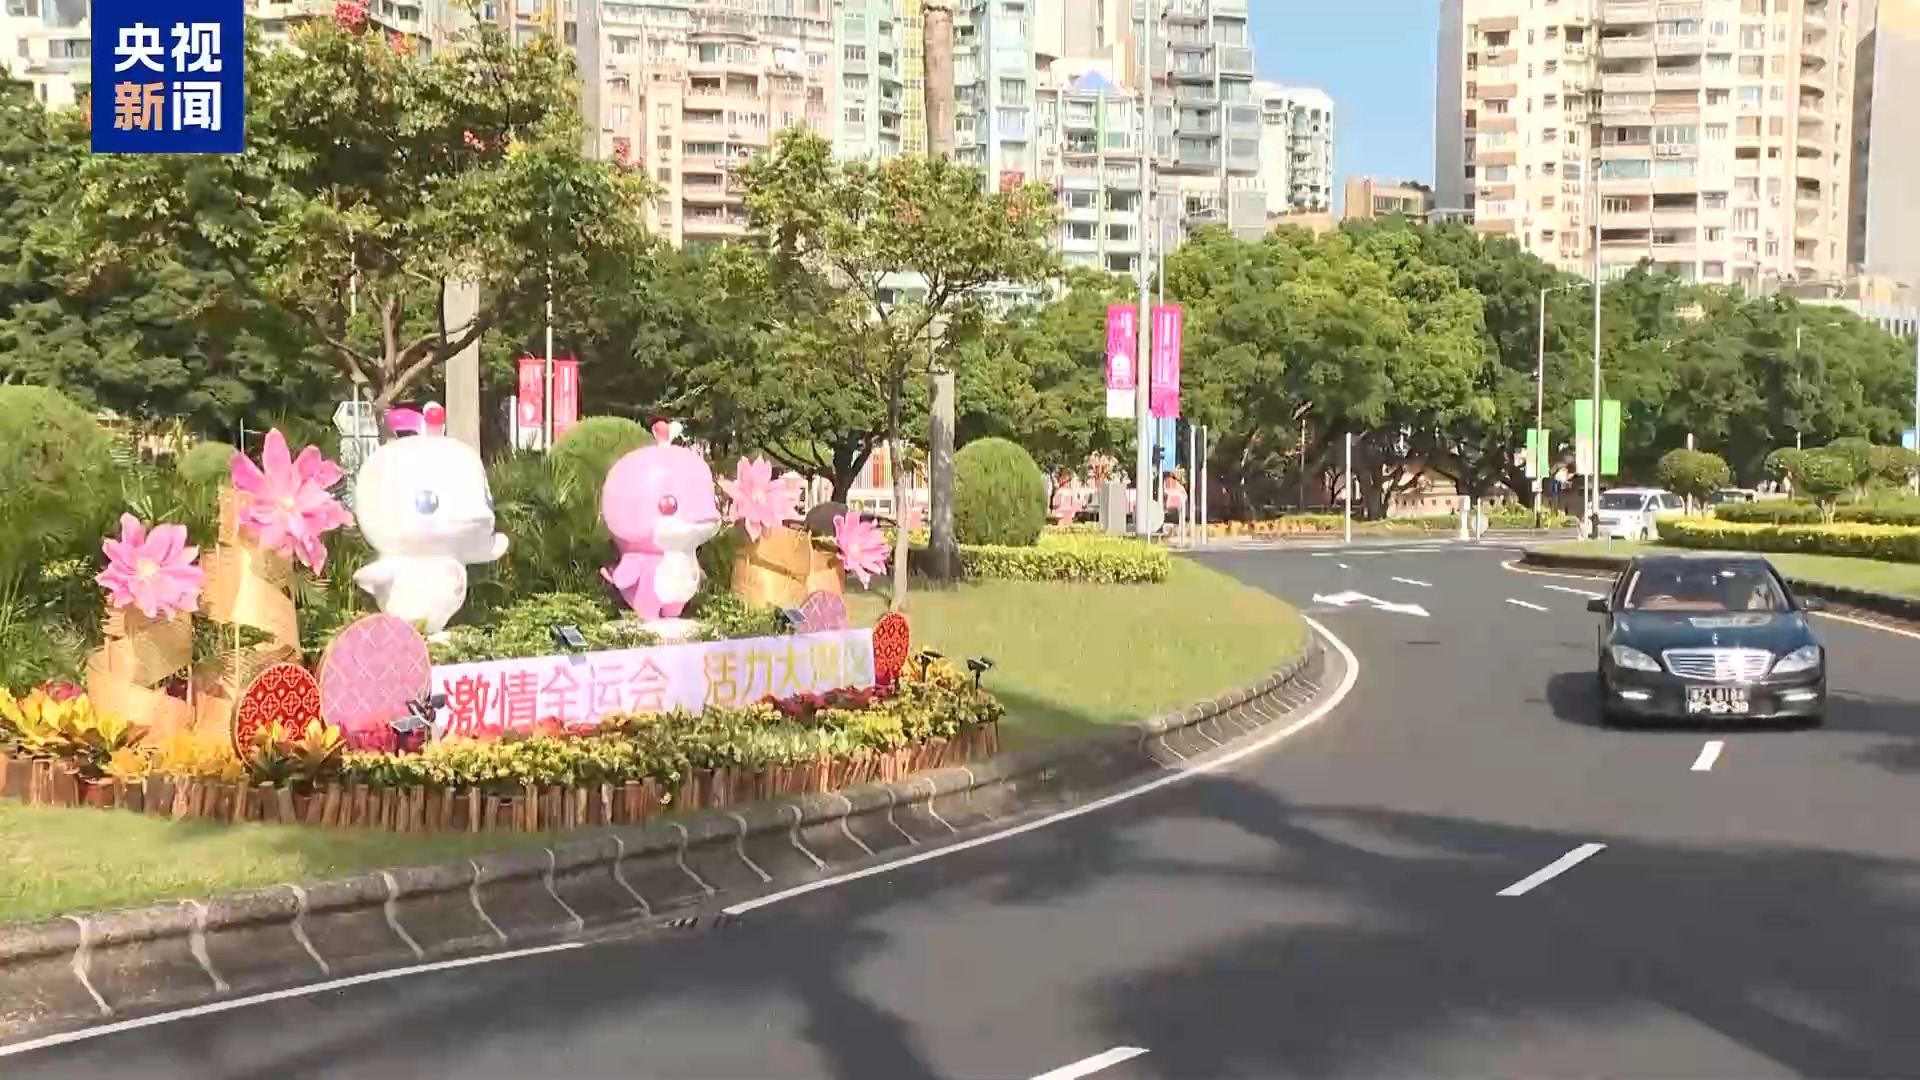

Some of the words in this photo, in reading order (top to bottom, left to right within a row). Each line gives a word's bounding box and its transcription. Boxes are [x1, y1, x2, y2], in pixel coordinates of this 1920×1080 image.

[442, 655, 671, 738] 激情全运会
